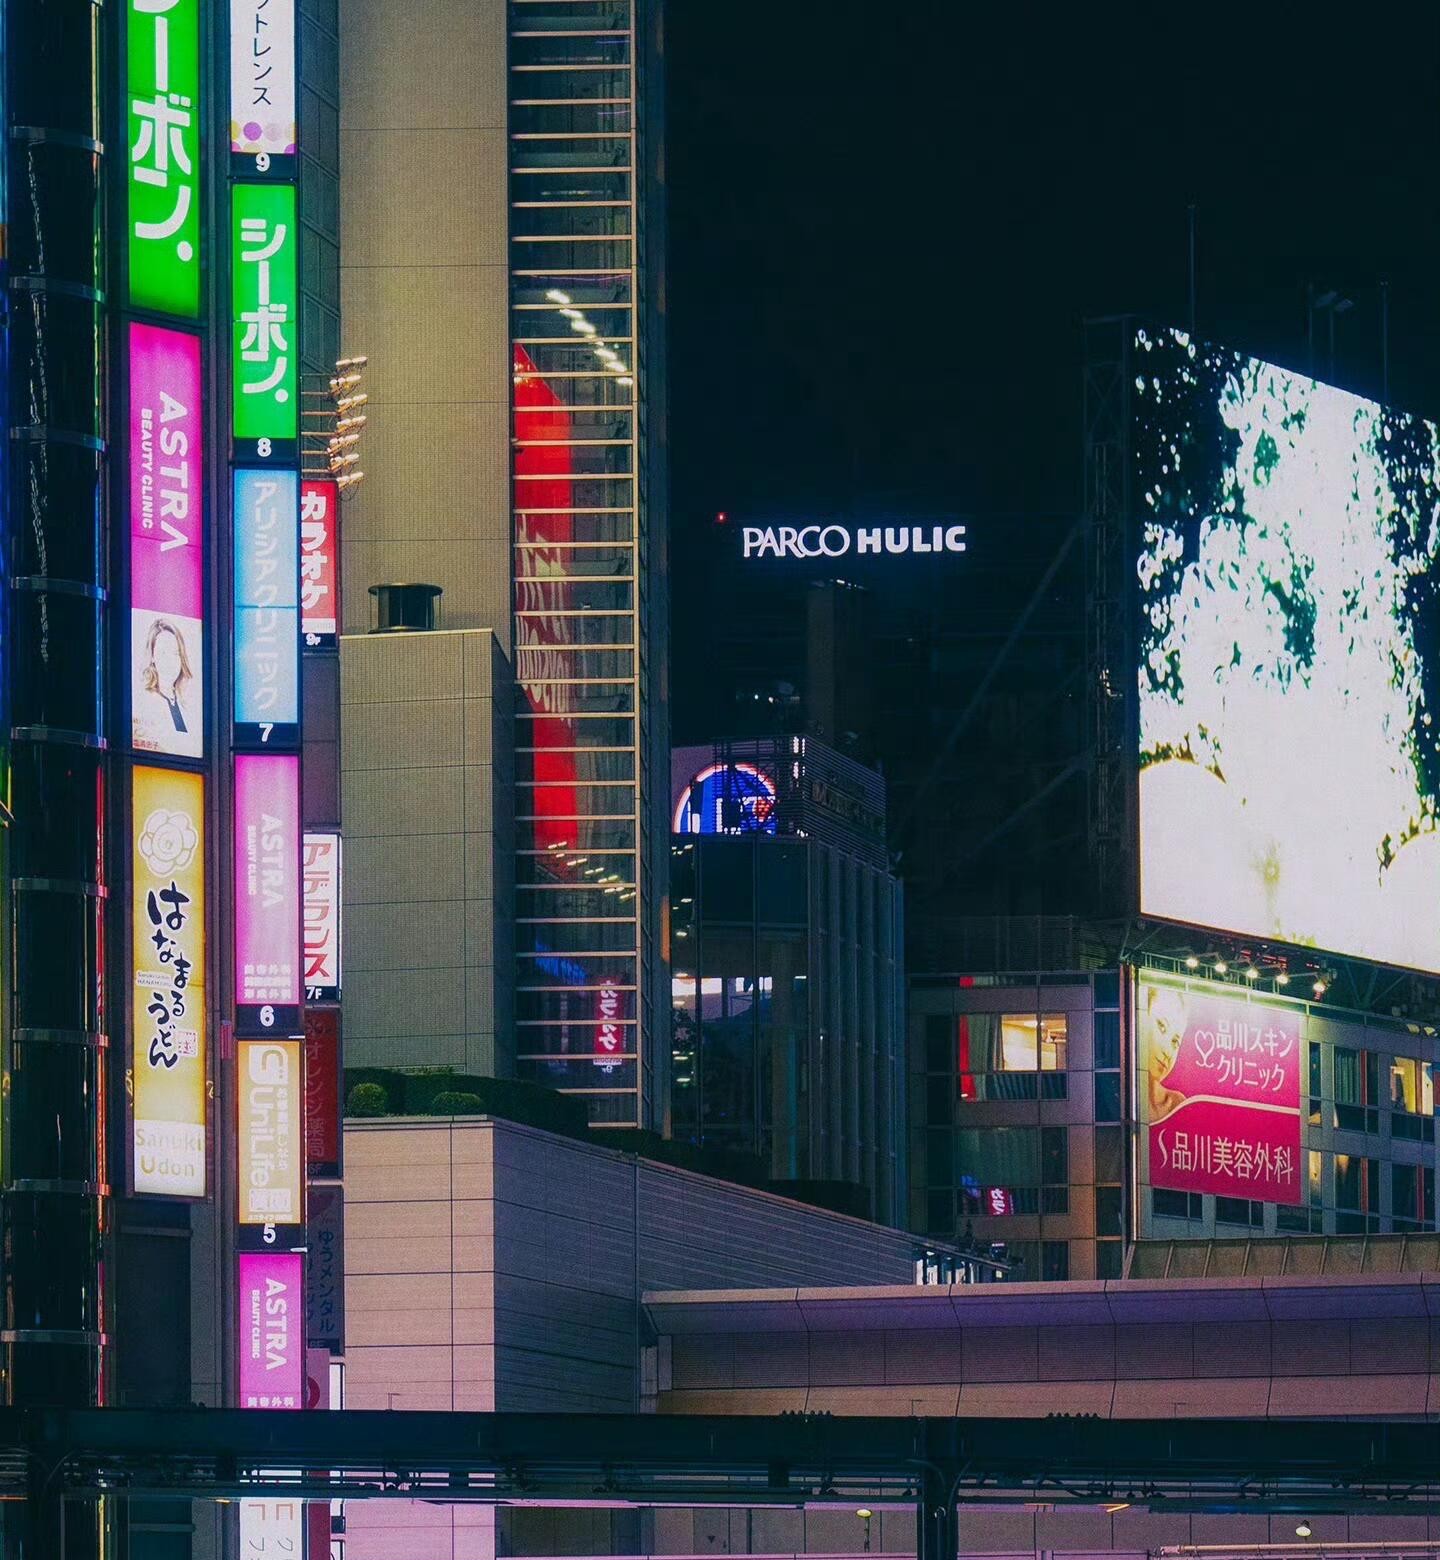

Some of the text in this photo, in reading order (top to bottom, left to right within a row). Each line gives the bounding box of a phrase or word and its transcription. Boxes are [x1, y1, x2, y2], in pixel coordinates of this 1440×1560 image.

[256, 153, 271, 172] 9
[257, 438, 272, 457] 8
[141, 408, 154, 529] BEAUTY CLINIC
[159, 391, 189, 552] ASTRA
[301, 491, 328, 610] カラオケ
[743, 525, 967, 558] PARCO HULIC
[254, 481, 279, 710] アリシアクリニック
[259, 723, 274, 742] 7
[261, 813, 286, 908] ASTRA
[303, 842, 332, 979] アデランス
[306, 987, 322, 1000] 7F
[260, 1005, 275, 1027] 6
[1216, 1018, 1294, 1058] 品川スキン
[1217, 1054, 1285, 1092] クリニック
[136, 1128, 202, 1152] Sanuki
[250, 1086, 276, 1187] UniLife
[140, 1155, 195, 1178] Udon
[1172, 1131, 1294, 1185] 品川美容外科
[263, 1223, 277, 1244] 5
[319, 1228, 335, 1333] ゆうメンタル
[265, 1278, 287, 1371] ASTRA
